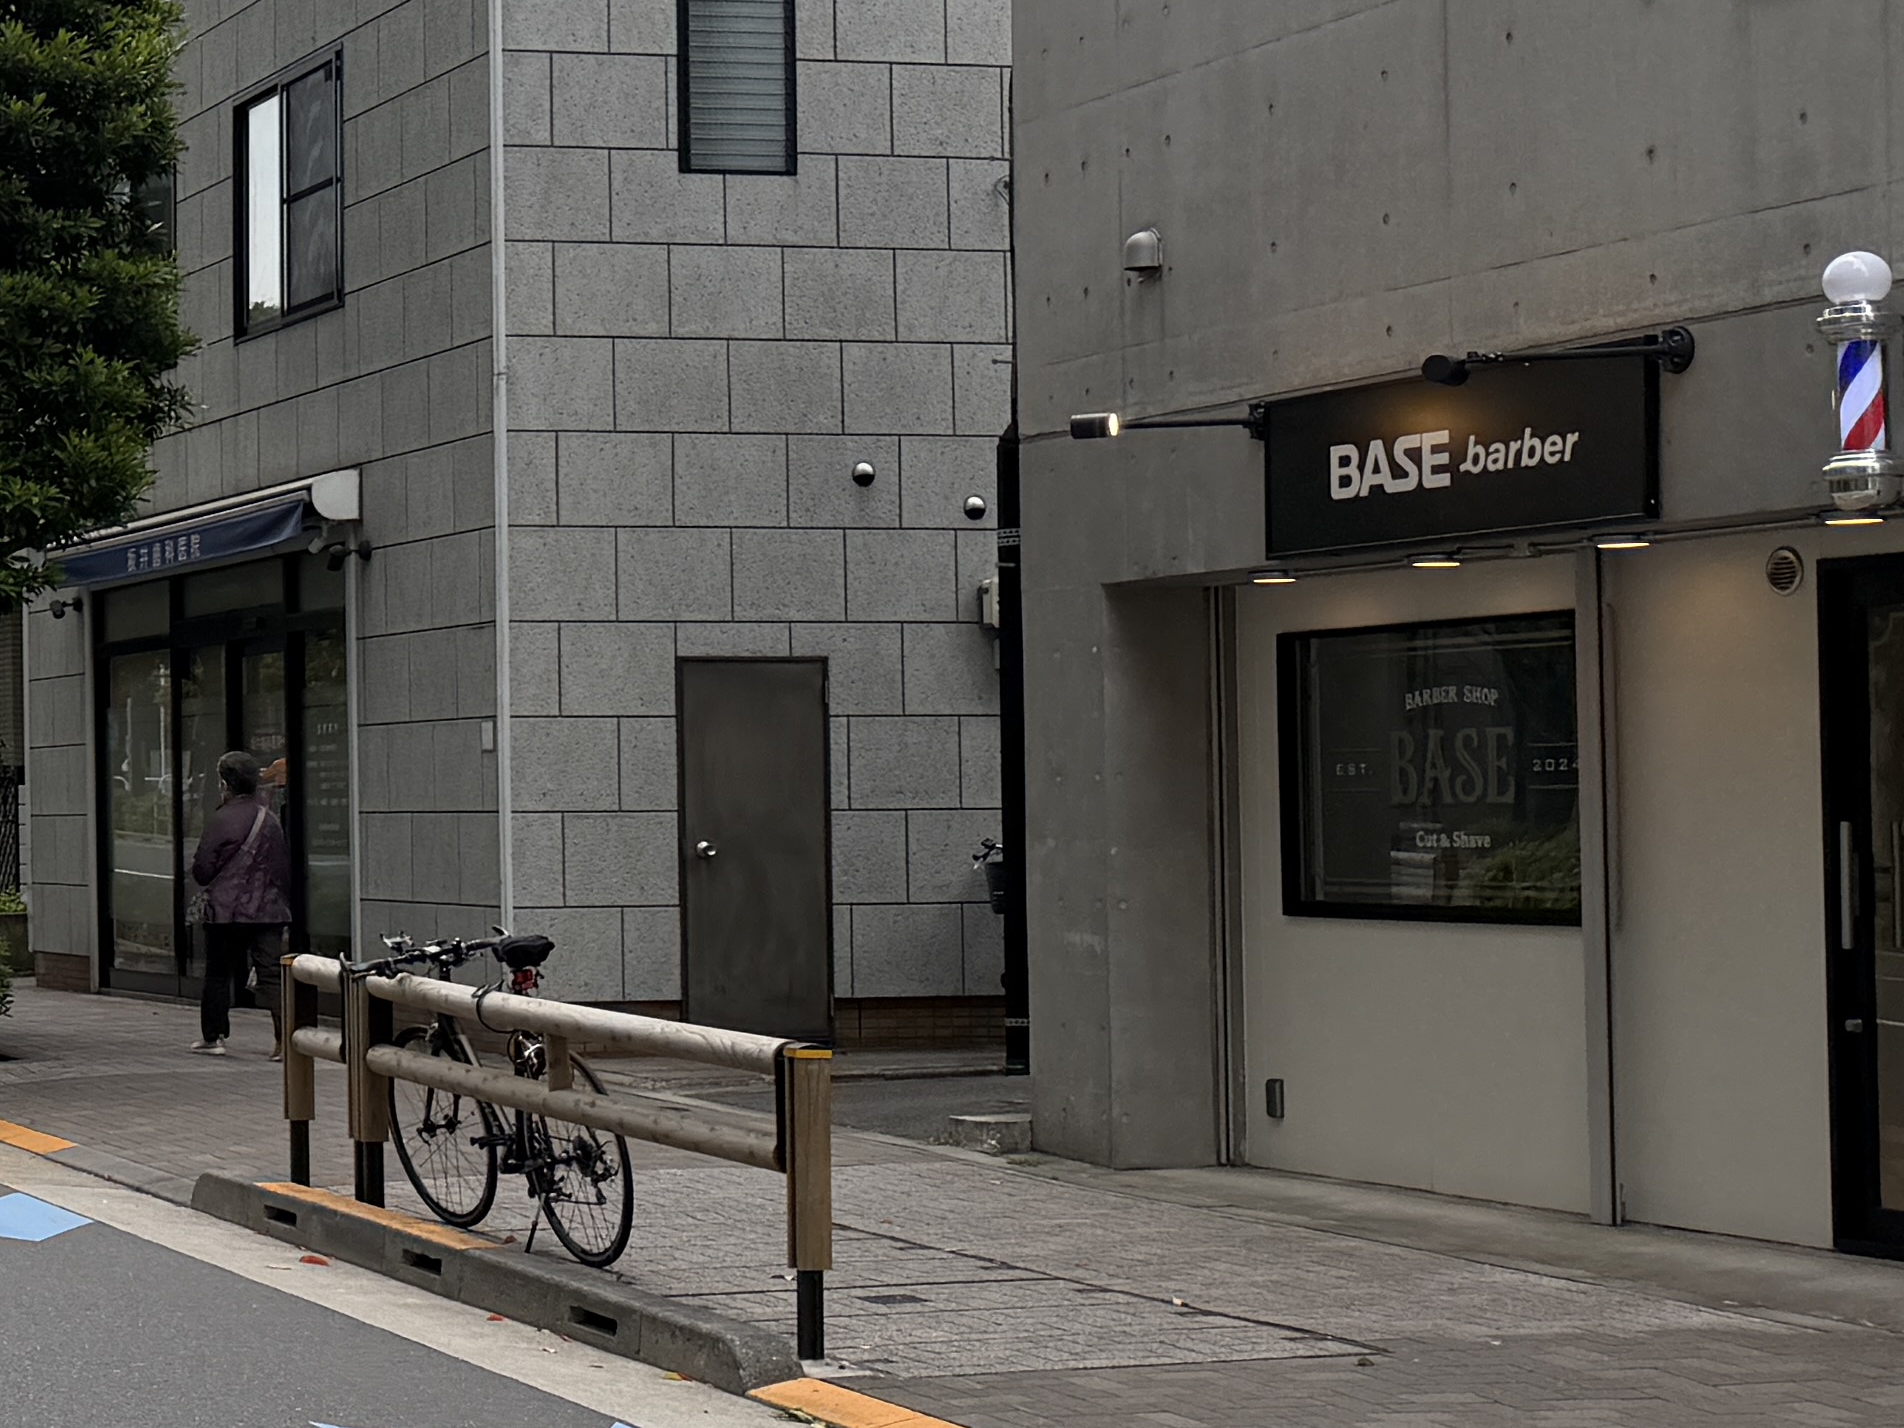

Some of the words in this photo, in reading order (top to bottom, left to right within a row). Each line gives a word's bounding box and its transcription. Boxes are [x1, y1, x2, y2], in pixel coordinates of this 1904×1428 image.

[1329, 429, 1451, 500] BASE
[1459, 427, 1579, 474] barber
[1405, 685, 1458, 710] BARBER
[1463, 685, 1499, 707] SHOP
[1335, 763, 1373, 776] EST.
[1390, 726, 1516, 806] BASE
[1415, 830, 1438, 848] Cut
[1439, 833, 1451, 848] &
[1452, 830, 1492, 849] Shave
